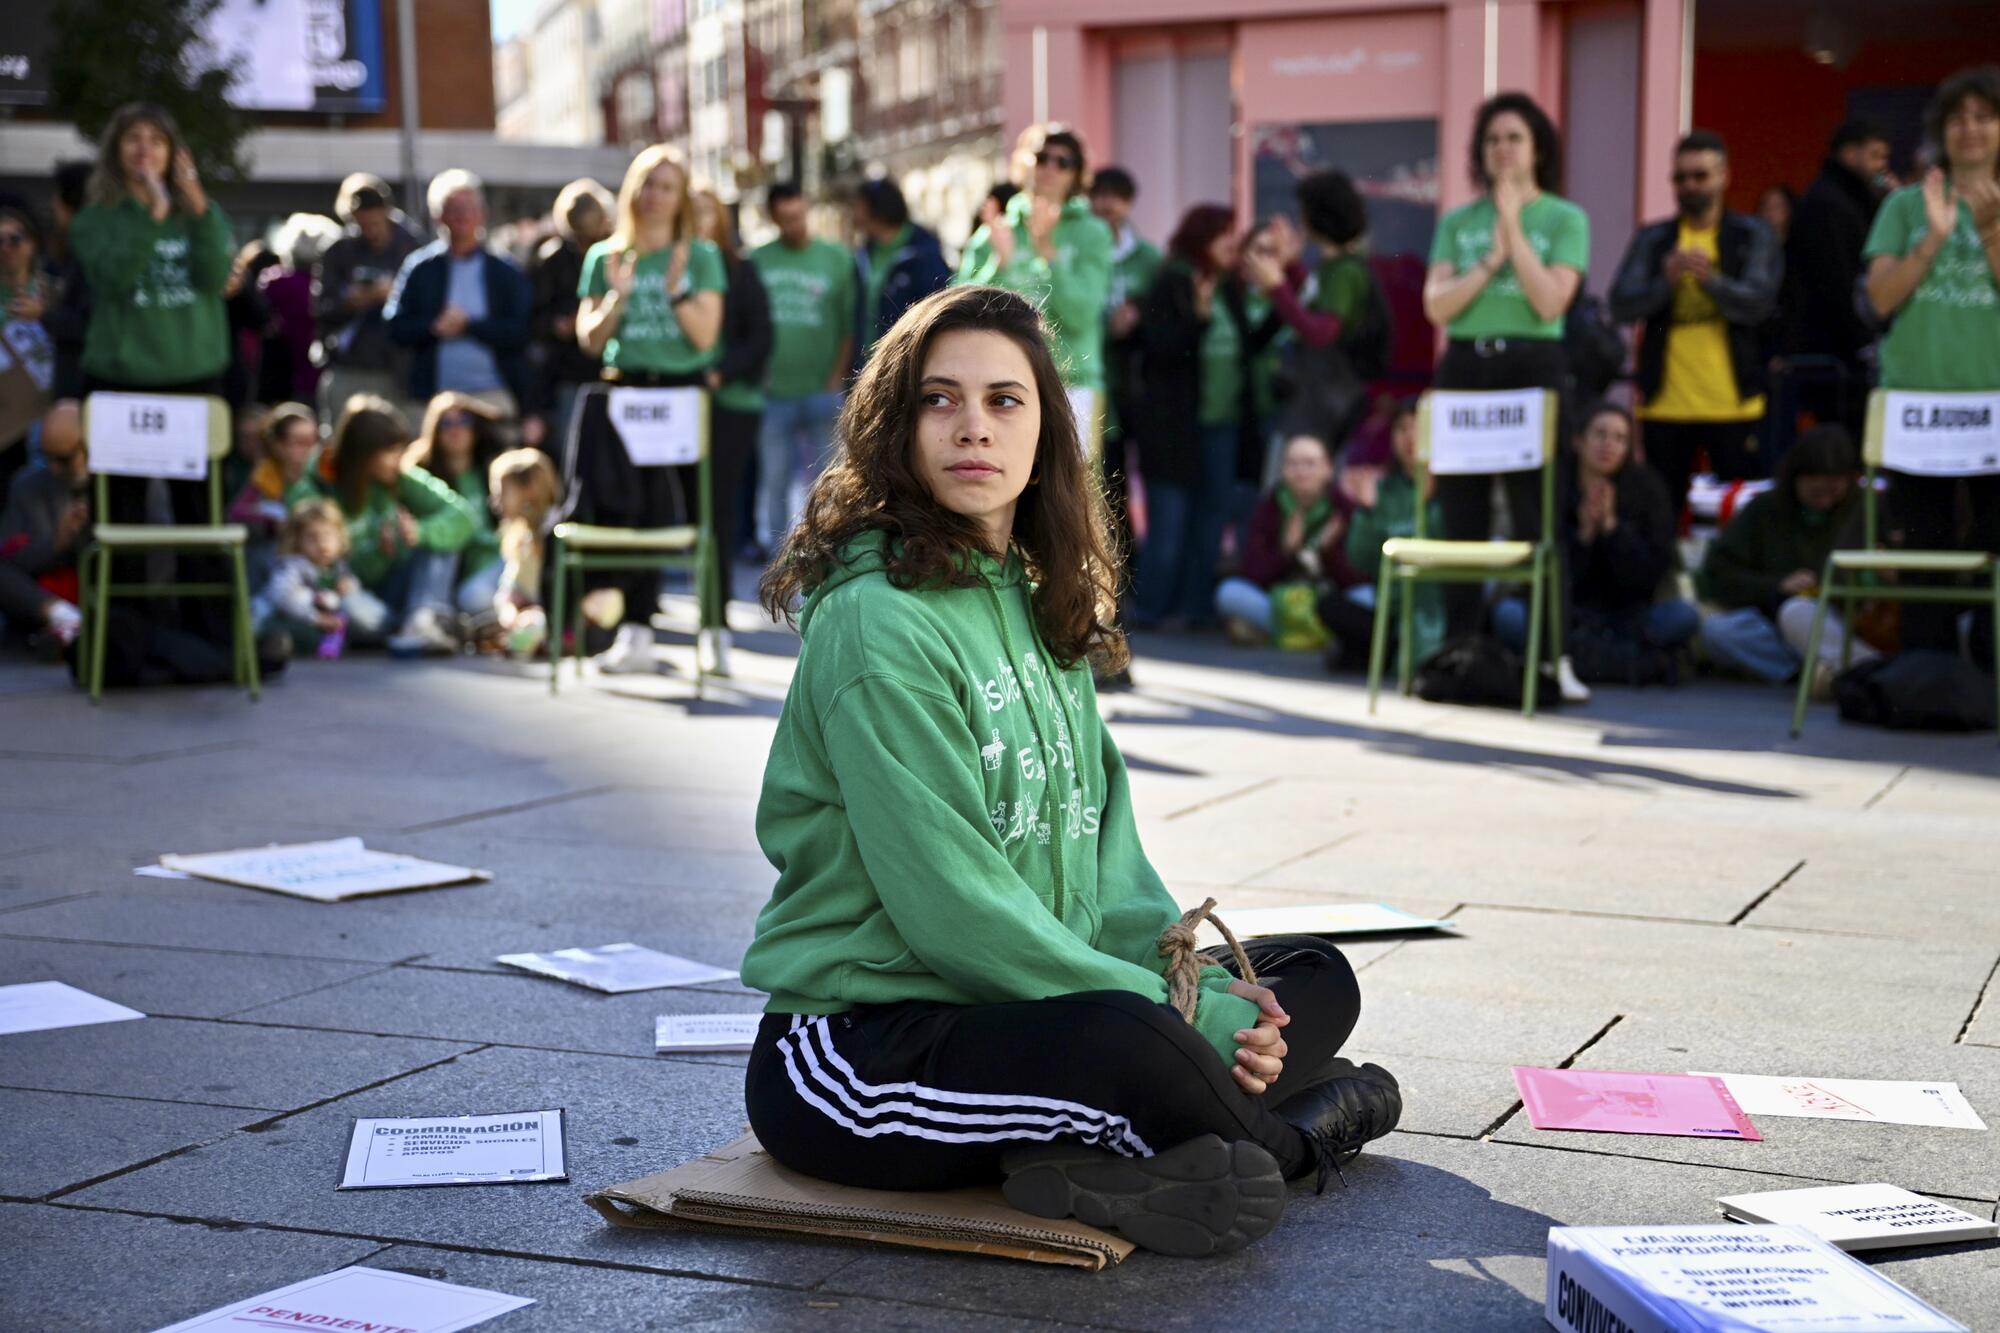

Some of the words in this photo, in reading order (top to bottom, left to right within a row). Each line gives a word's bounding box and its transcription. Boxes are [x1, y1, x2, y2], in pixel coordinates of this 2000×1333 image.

[1902, 406, 1991, 428] CLAUDIA
[375, 1121, 539, 1135] COORDINACIÓN
[1820, 1203, 1939, 1217] PROFESIONAL
[1853, 1209, 1956, 1223] FORMACIÓN
[1889, 1216, 1975, 1228] ESTUDIAR
[1622, 1234, 1770, 1245] EVALUACIONES
[1611, 1244, 1812, 1256] PSICOPEDAGÓGICAS
[1680, 1267, 1830, 1277] AUTORIZACIONES
[1693, 1276, 1812, 1287] ENTREVISTAS
[1707, 1287, 1792, 1298] PRUEBAS
[1721, 1297, 1818, 1308] INFORMES
